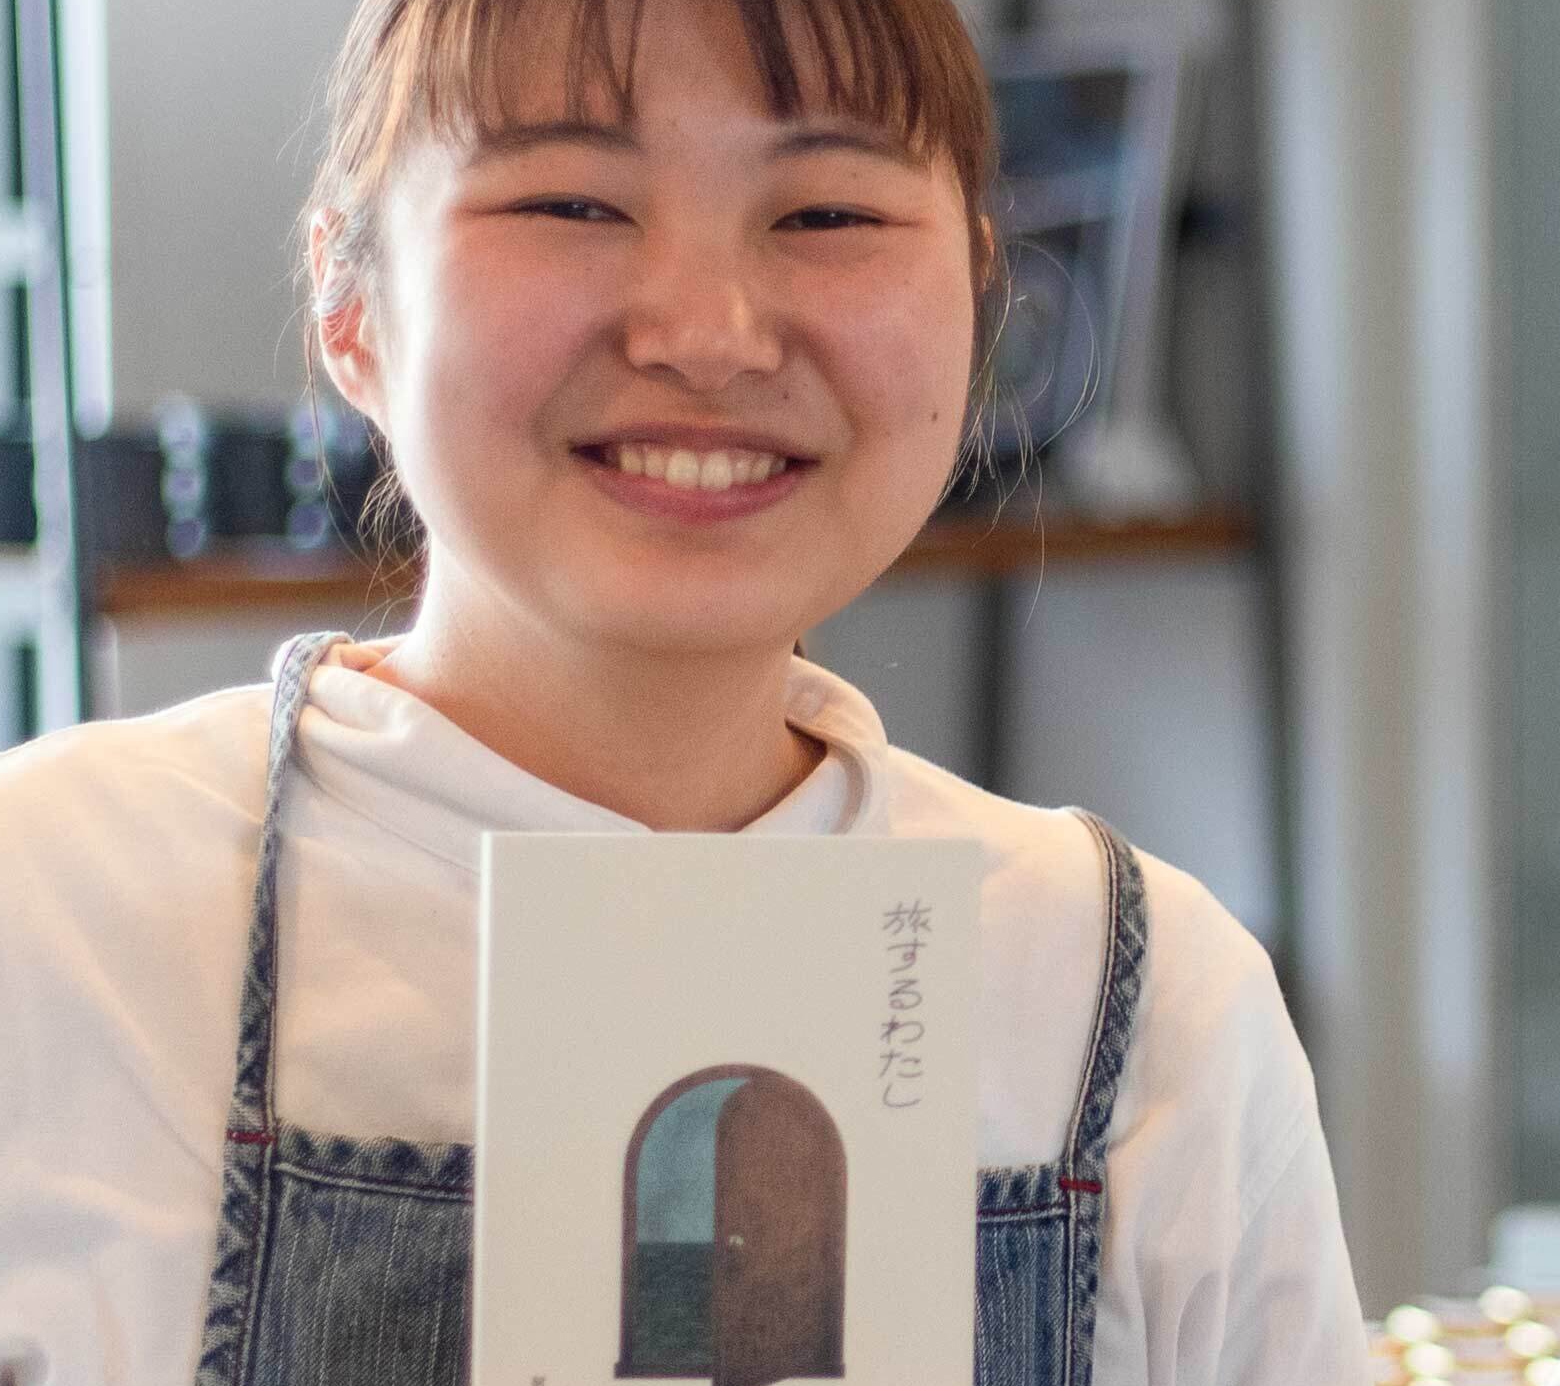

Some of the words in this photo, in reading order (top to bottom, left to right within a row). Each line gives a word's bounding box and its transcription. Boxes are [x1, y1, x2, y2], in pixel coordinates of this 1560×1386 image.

[880, 899, 932, 1108] 旅するわたし
